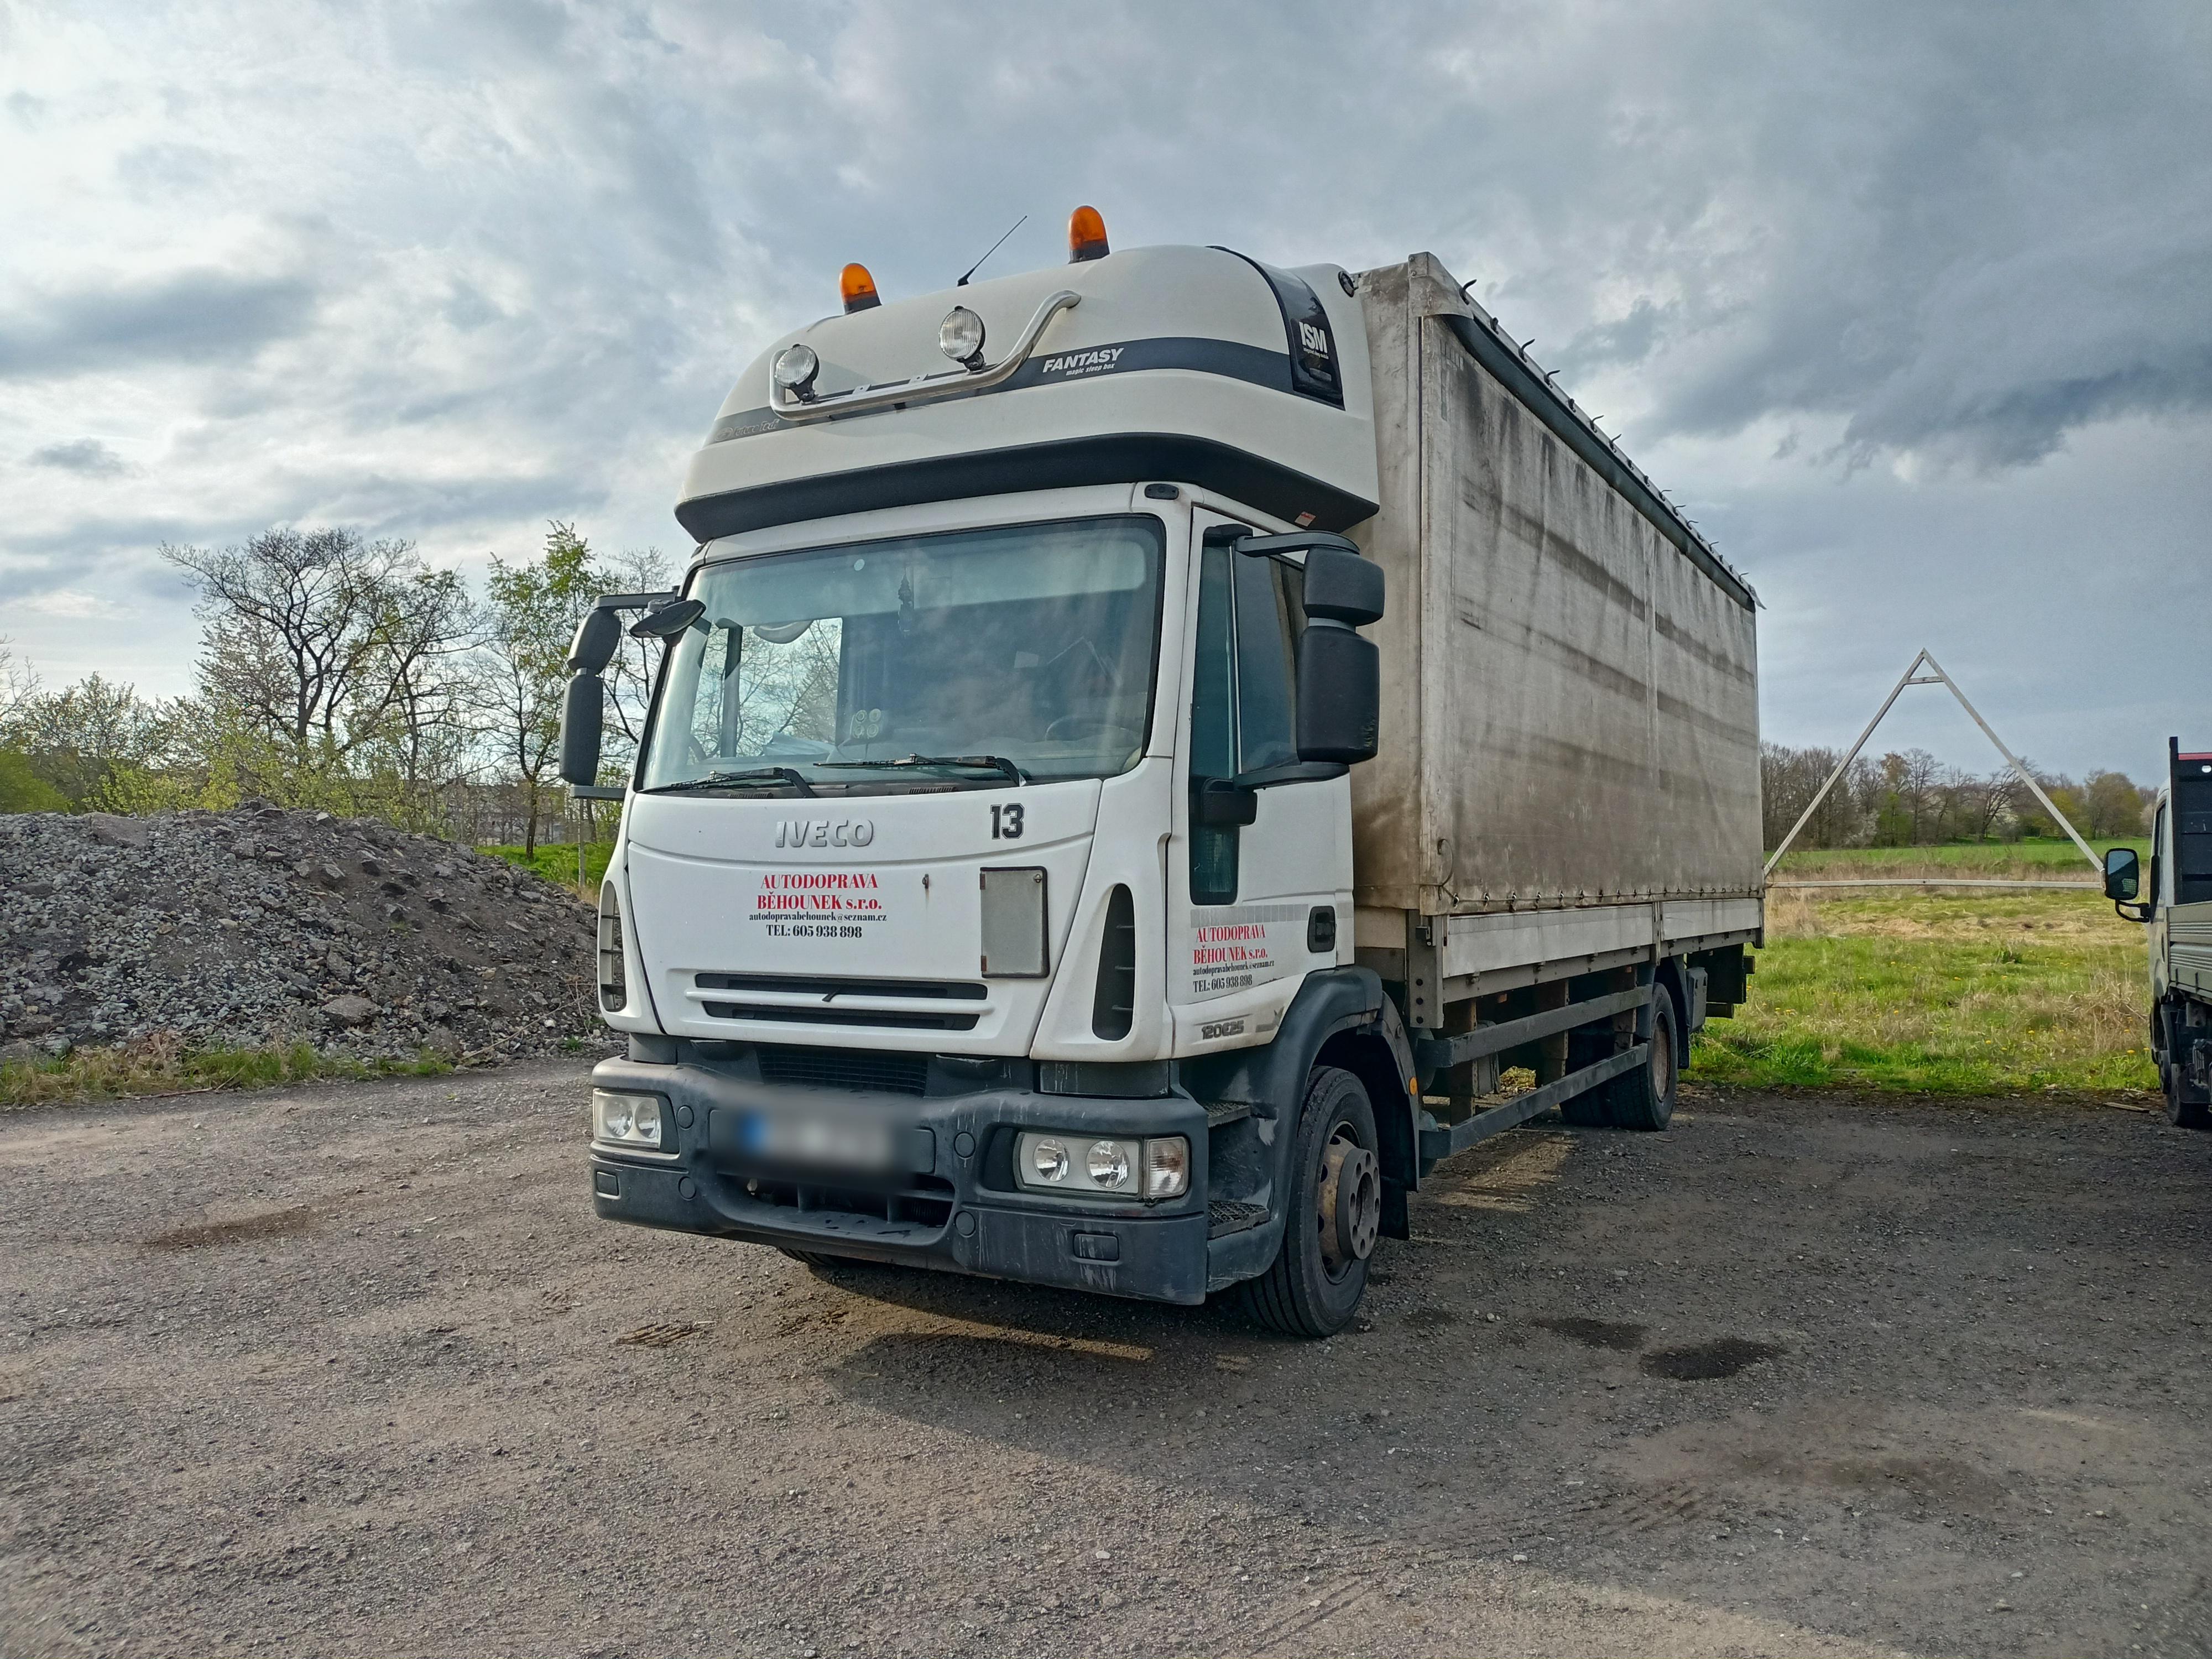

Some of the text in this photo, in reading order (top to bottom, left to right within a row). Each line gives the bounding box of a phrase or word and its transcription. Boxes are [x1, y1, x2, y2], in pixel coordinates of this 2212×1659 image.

[1298, 321, 1328, 353] ISM
[1042, 347, 1124, 373] FANTASY
[1066, 367, 1084, 376] magic
[1086, 364, 1102, 373] sleep
[989, 803, 1025, 839] 13
[774, 819, 874, 848] IVECO
[760, 873, 878, 889] AUTODOPRAVA
[757, 891, 882, 910] BĚHOUNEK s.r.o.
[749, 911, 887, 922] autodopravabehounek@seznam.cz
[766, 925, 862, 938] TEL: 605 938 898
[1196, 924, 1266, 943] AUTODOPRAVA
[1193, 945, 1268, 964] BĚHOUNEK s.r.o.
[1193, 974, 1253, 993] TEL: 605 938 898
